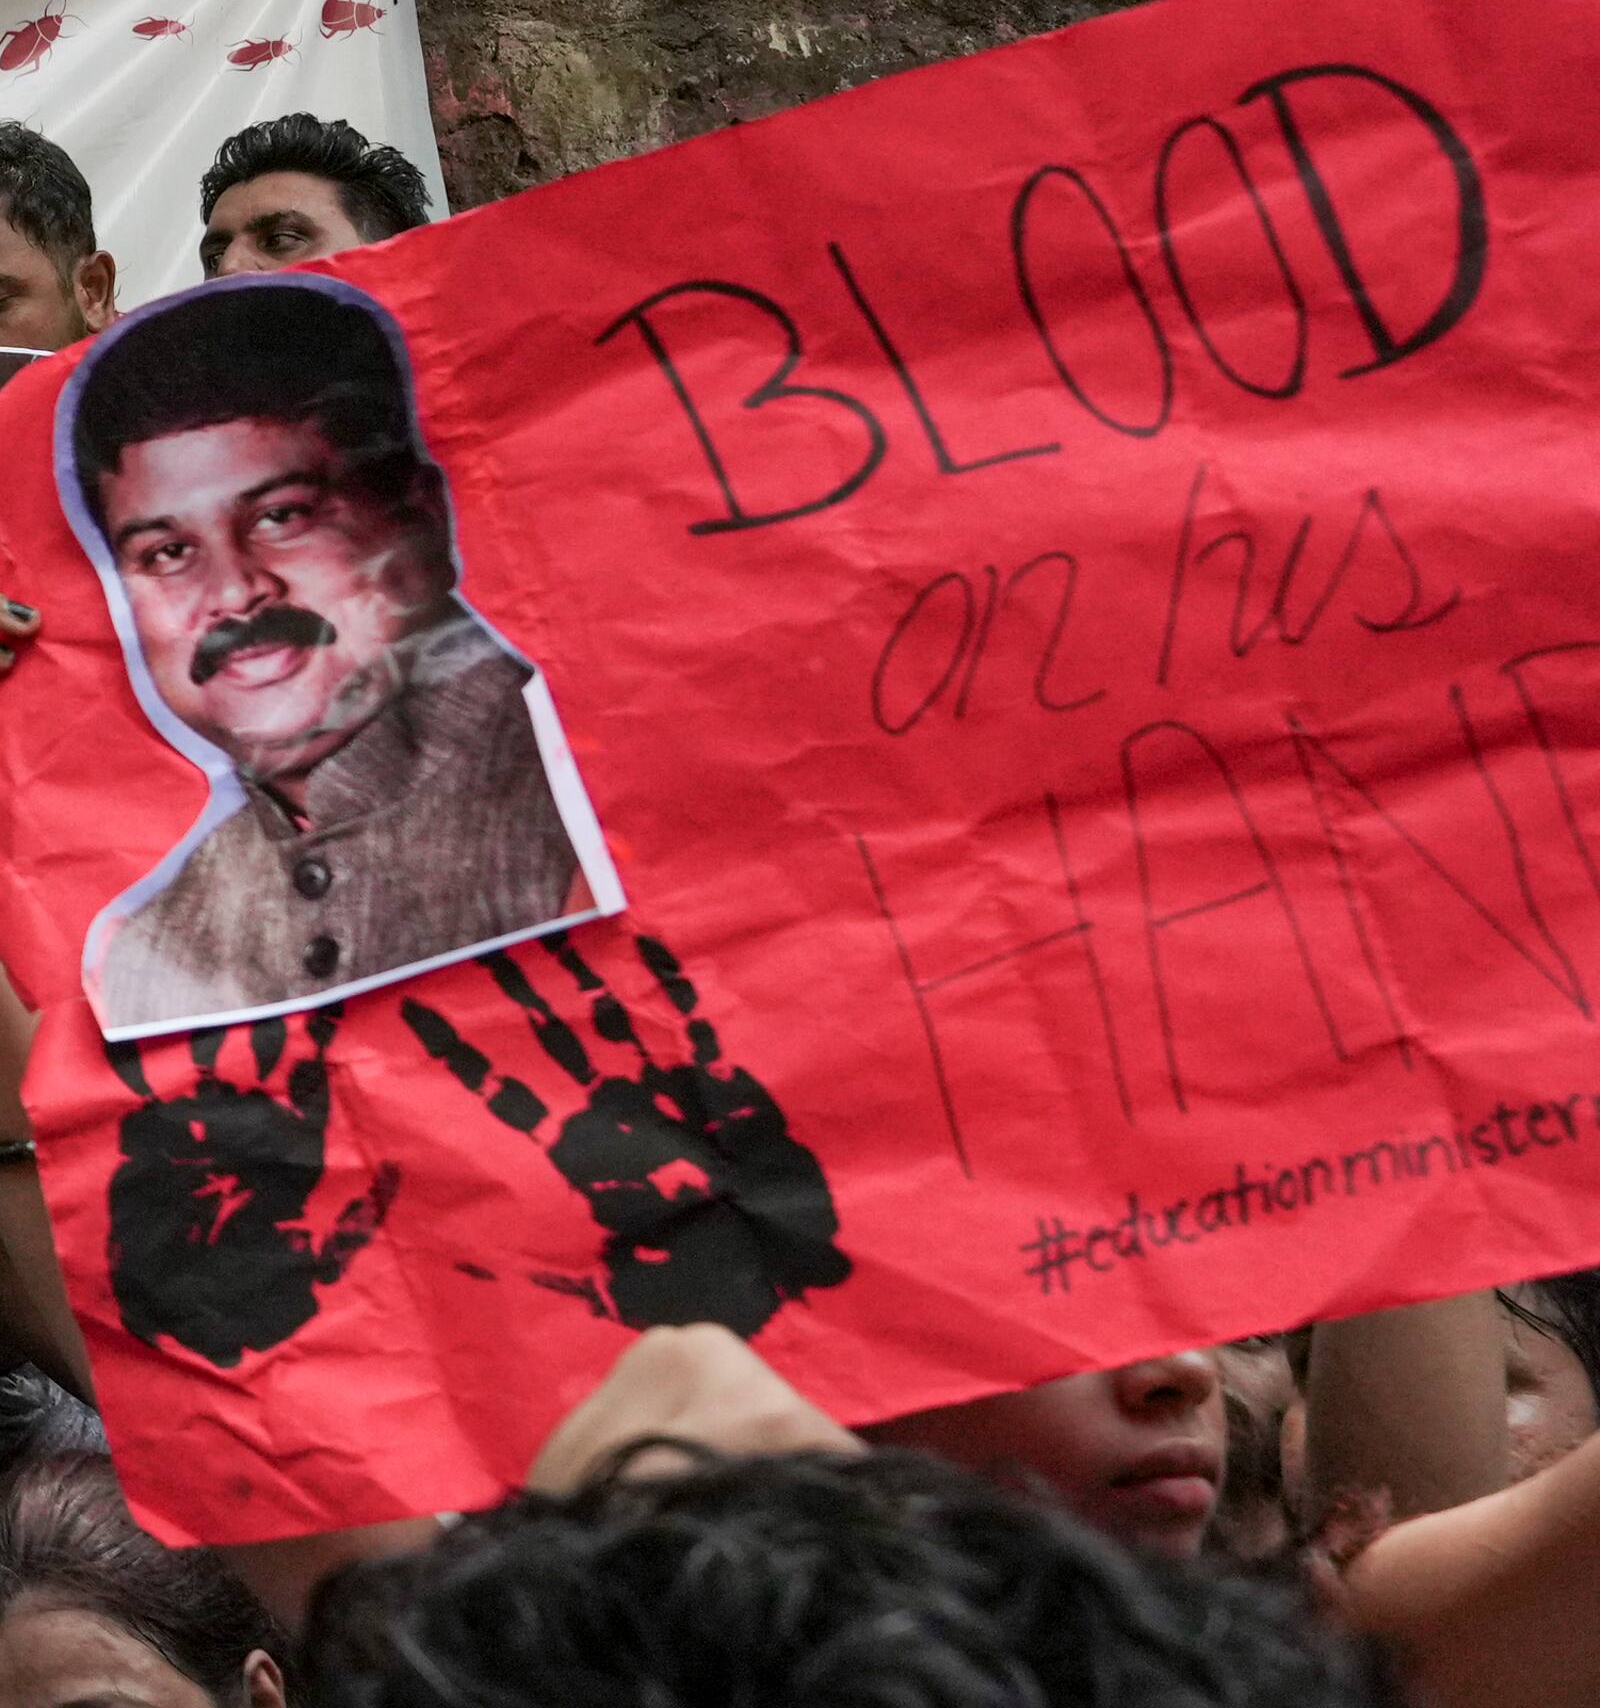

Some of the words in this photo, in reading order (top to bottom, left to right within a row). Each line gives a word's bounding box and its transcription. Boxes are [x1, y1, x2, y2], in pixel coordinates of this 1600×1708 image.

[592, 62, 1489, 538] BLOOD
[870, 549, 1106, 736] on
[1156, 467, 1463, 685] his
[1018, 1091, 1600, 1296] #educationminister
